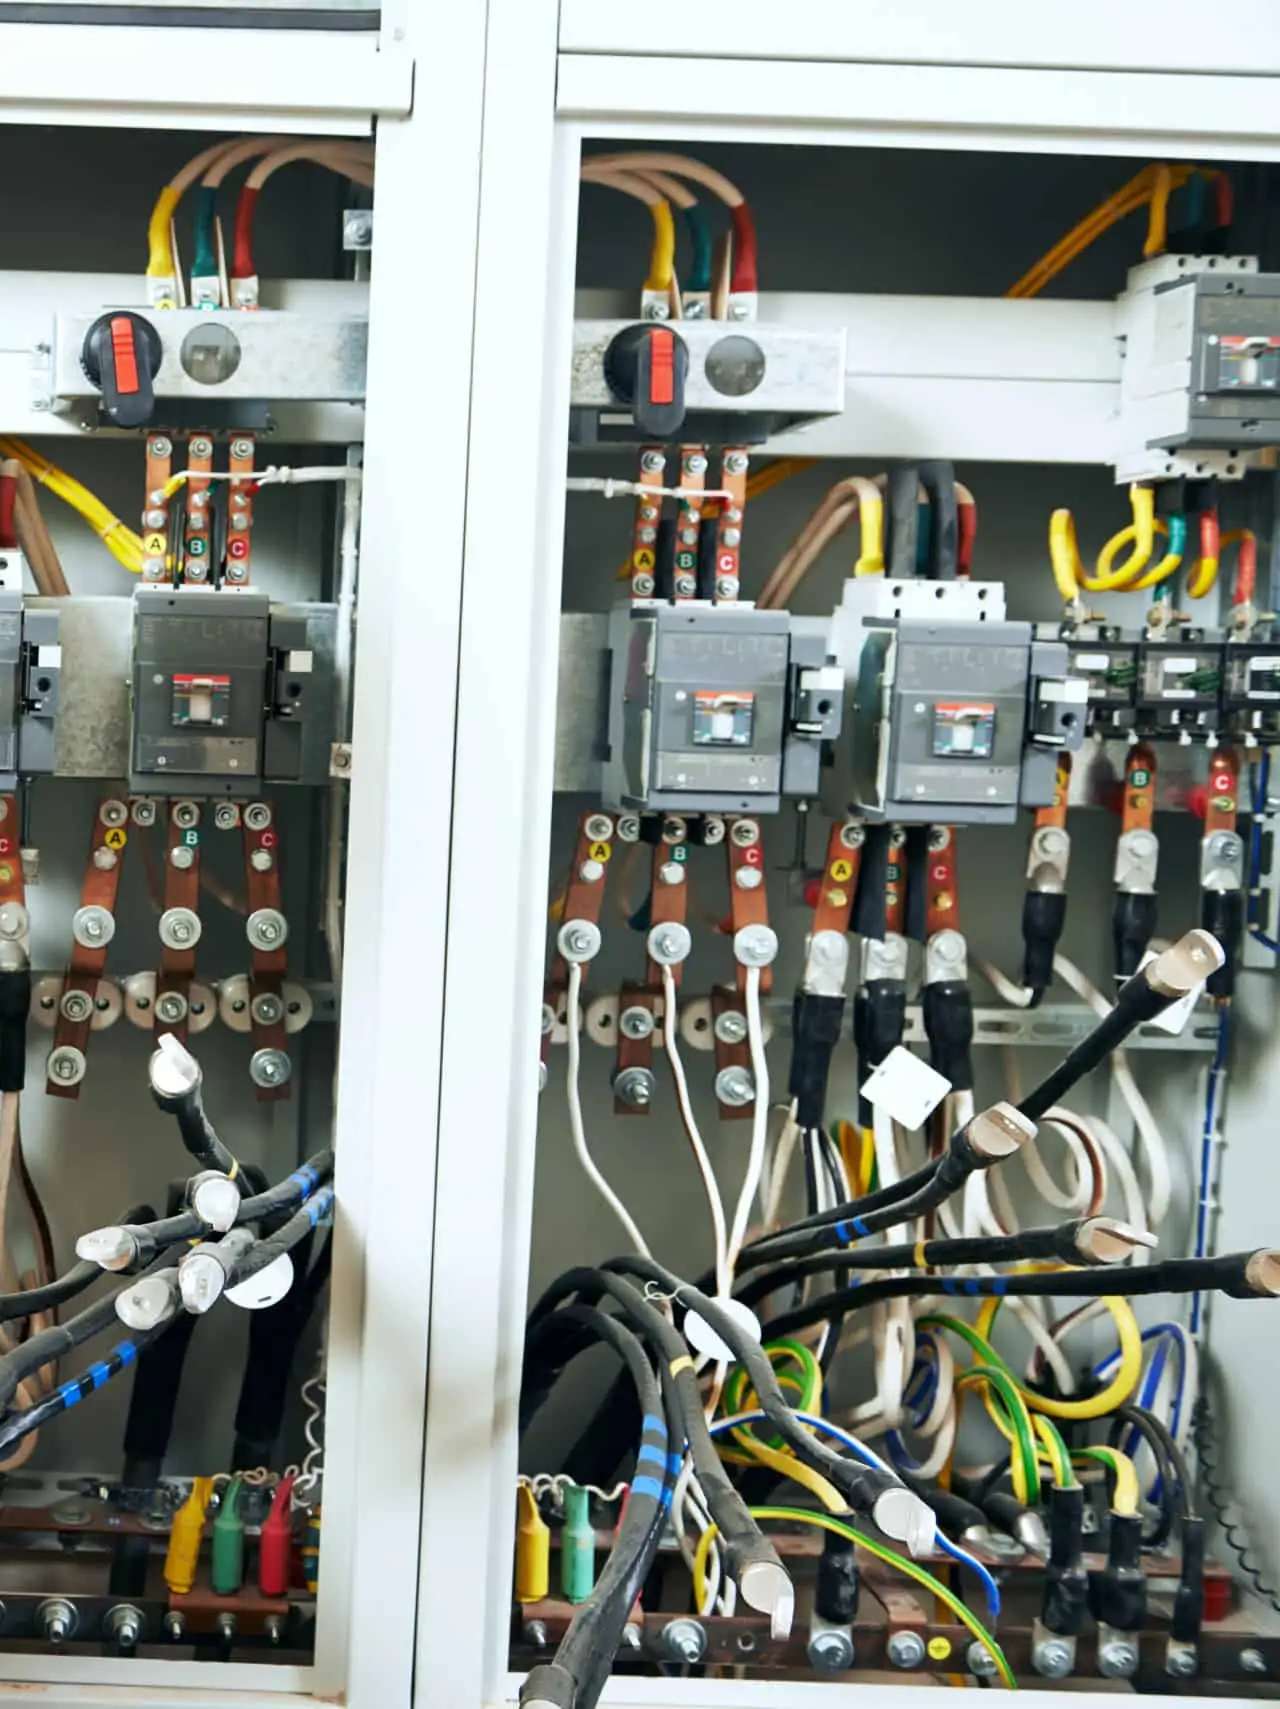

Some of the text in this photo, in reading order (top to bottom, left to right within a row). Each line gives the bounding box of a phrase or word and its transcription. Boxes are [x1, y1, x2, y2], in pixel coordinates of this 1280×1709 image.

[150, 537, 161, 551] A
[190, 540, 202, 555] B
[232, 541, 244, 556] C
[638, 551, 651, 566] A
[680, 553, 693, 568] B
[720, 555, 733, 571] C
[1134, 771, 1147, 786] B
[1215, 775, 1229, 790] C
[109, 831, 122, 845] A
[185, 830, 198, 845] B
[261, 832, 273, 847] C
[594, 844, 606, 858] A
[673, 846, 686, 861] B
[746, 848, 759, 863] C
[835, 863, 847, 877] A
[887, 866, 898, 880] B
[934, 865, 947, 880] C
